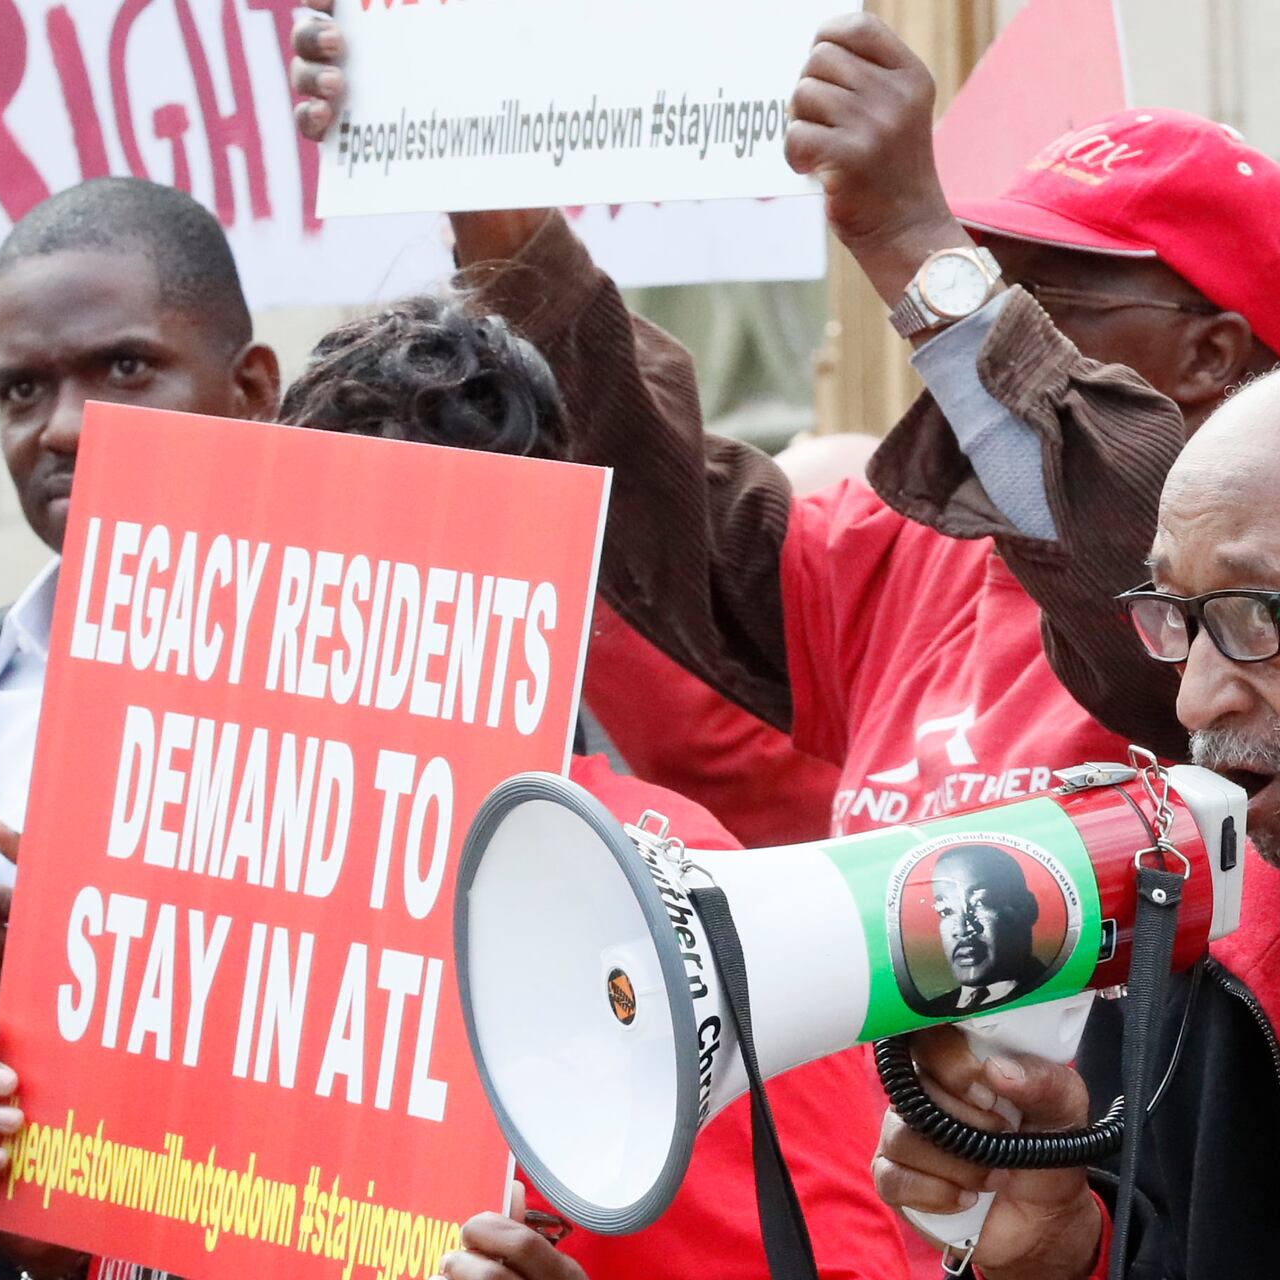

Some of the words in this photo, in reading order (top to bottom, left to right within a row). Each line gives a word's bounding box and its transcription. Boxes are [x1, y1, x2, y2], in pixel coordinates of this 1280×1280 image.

[337, 93, 643, 178] #peoplestownwillnotgodown
[70, 517, 270, 685] LEGACY
[266, 546, 558, 736] RESIDENTS
[107, 705, 354, 898] DEMAND
[371, 752, 454, 920] TO
[57, 885, 234, 1068] STAY
[232, 923, 315, 1090] IN
[315, 943, 449, 1122] ATL
